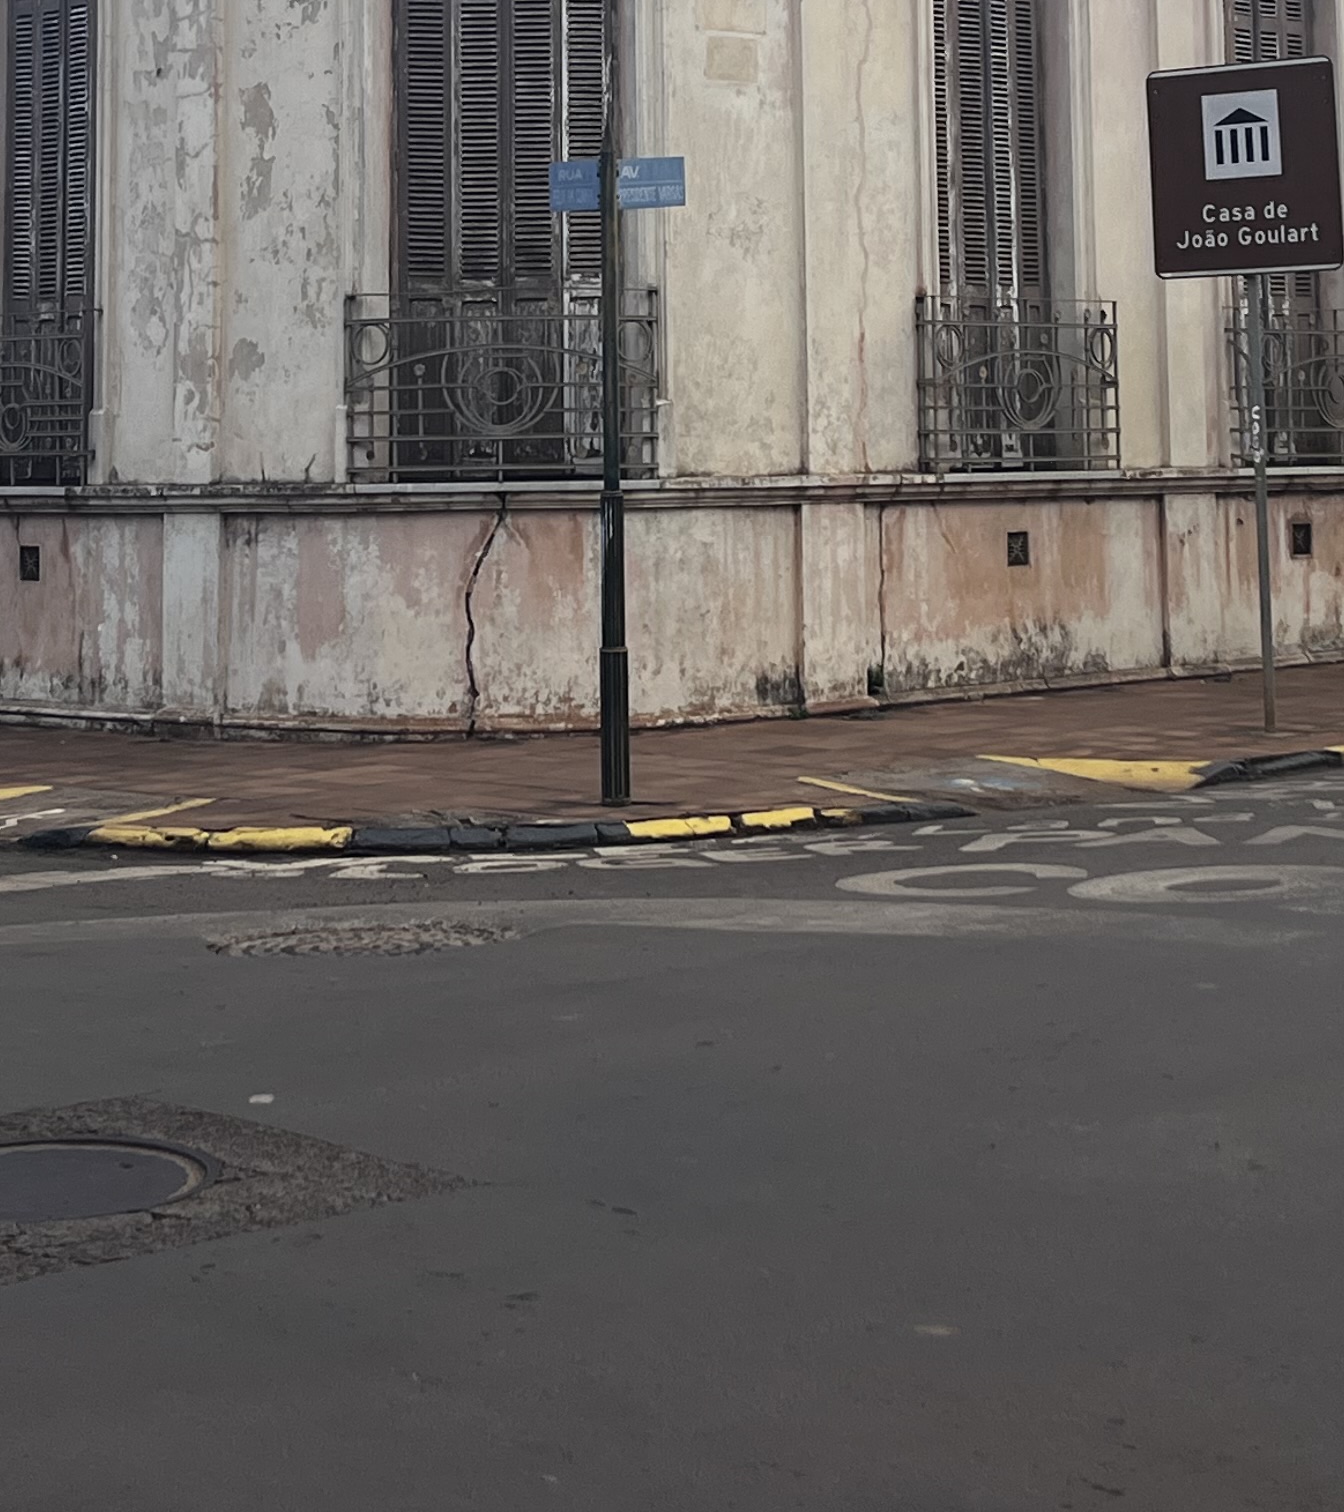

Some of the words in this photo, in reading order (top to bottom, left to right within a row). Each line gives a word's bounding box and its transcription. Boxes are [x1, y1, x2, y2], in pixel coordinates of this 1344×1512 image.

[558, 168, 583, 182] RUA
[1202, 204, 1255, 223] Casa
[1263, 201, 1288, 219] de
[1176, 230, 1228, 249] João
[1238, 223, 1319, 245] Goulart
